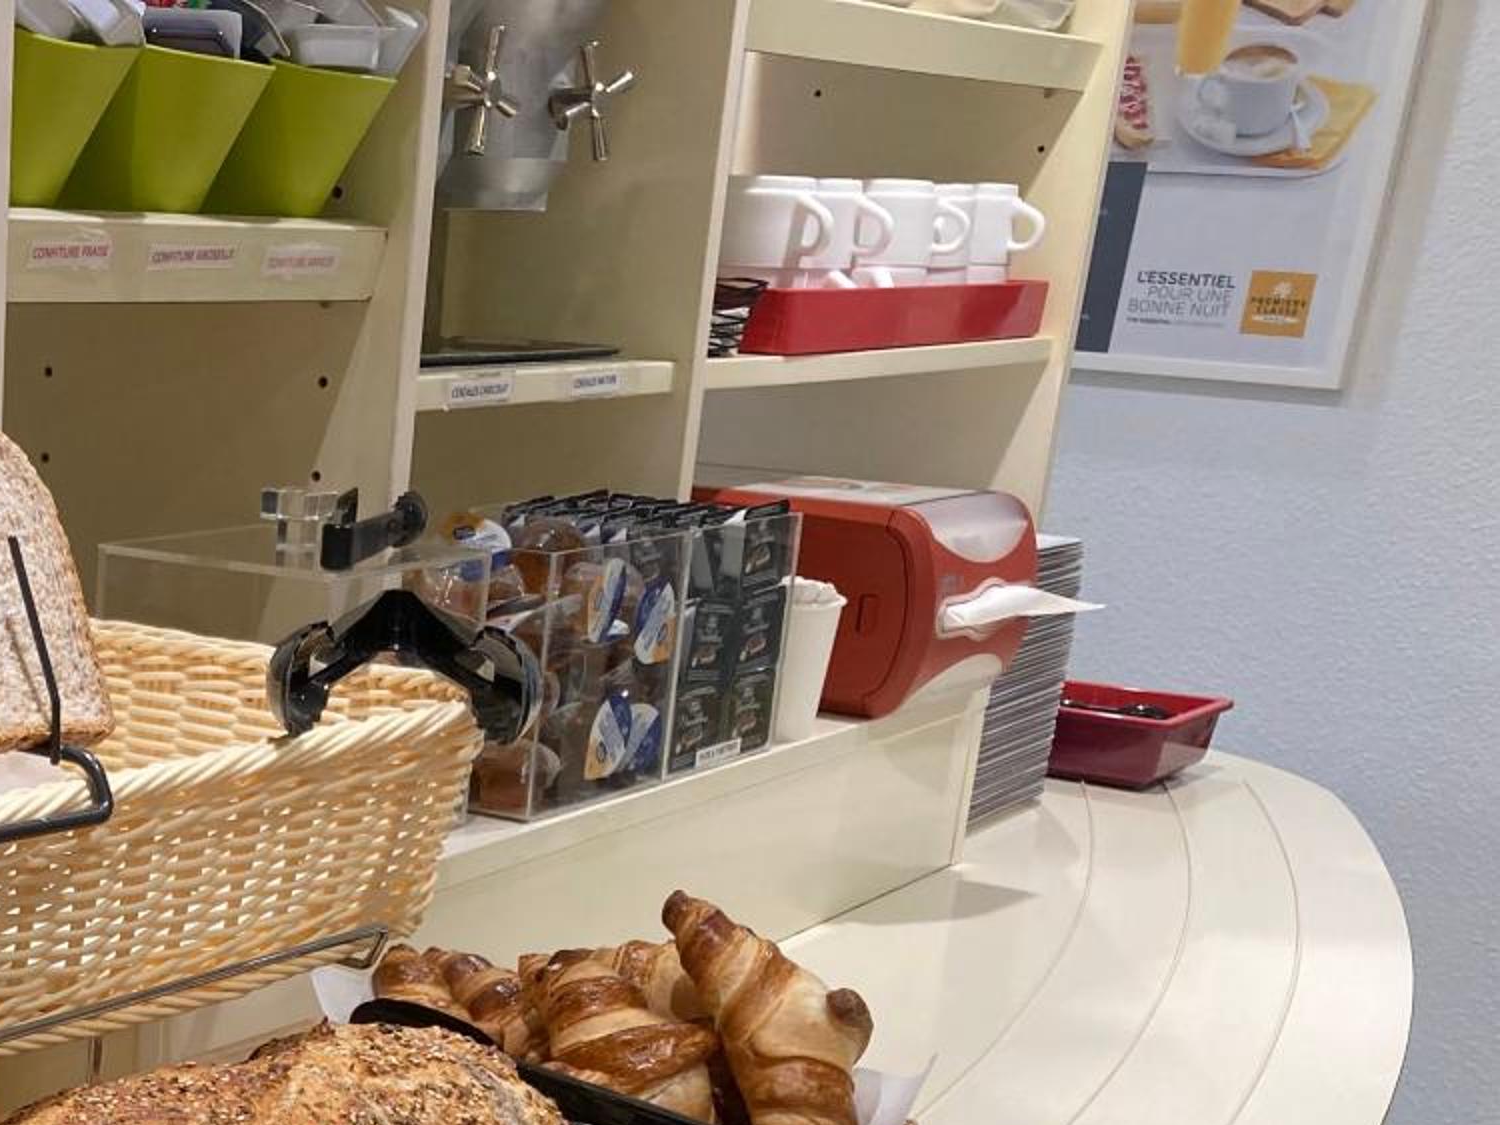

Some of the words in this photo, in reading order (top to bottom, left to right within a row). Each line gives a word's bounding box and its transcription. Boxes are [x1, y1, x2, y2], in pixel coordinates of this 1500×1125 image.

[1137, 270, 1235, 289] L'ESSENTIEL
[1148, 286, 1193, 300] POUR
[1198, 287, 1232, 302] UNE
[1127, 299, 1186, 315] BONNE
[1190, 301, 1229, 317] NUIT
